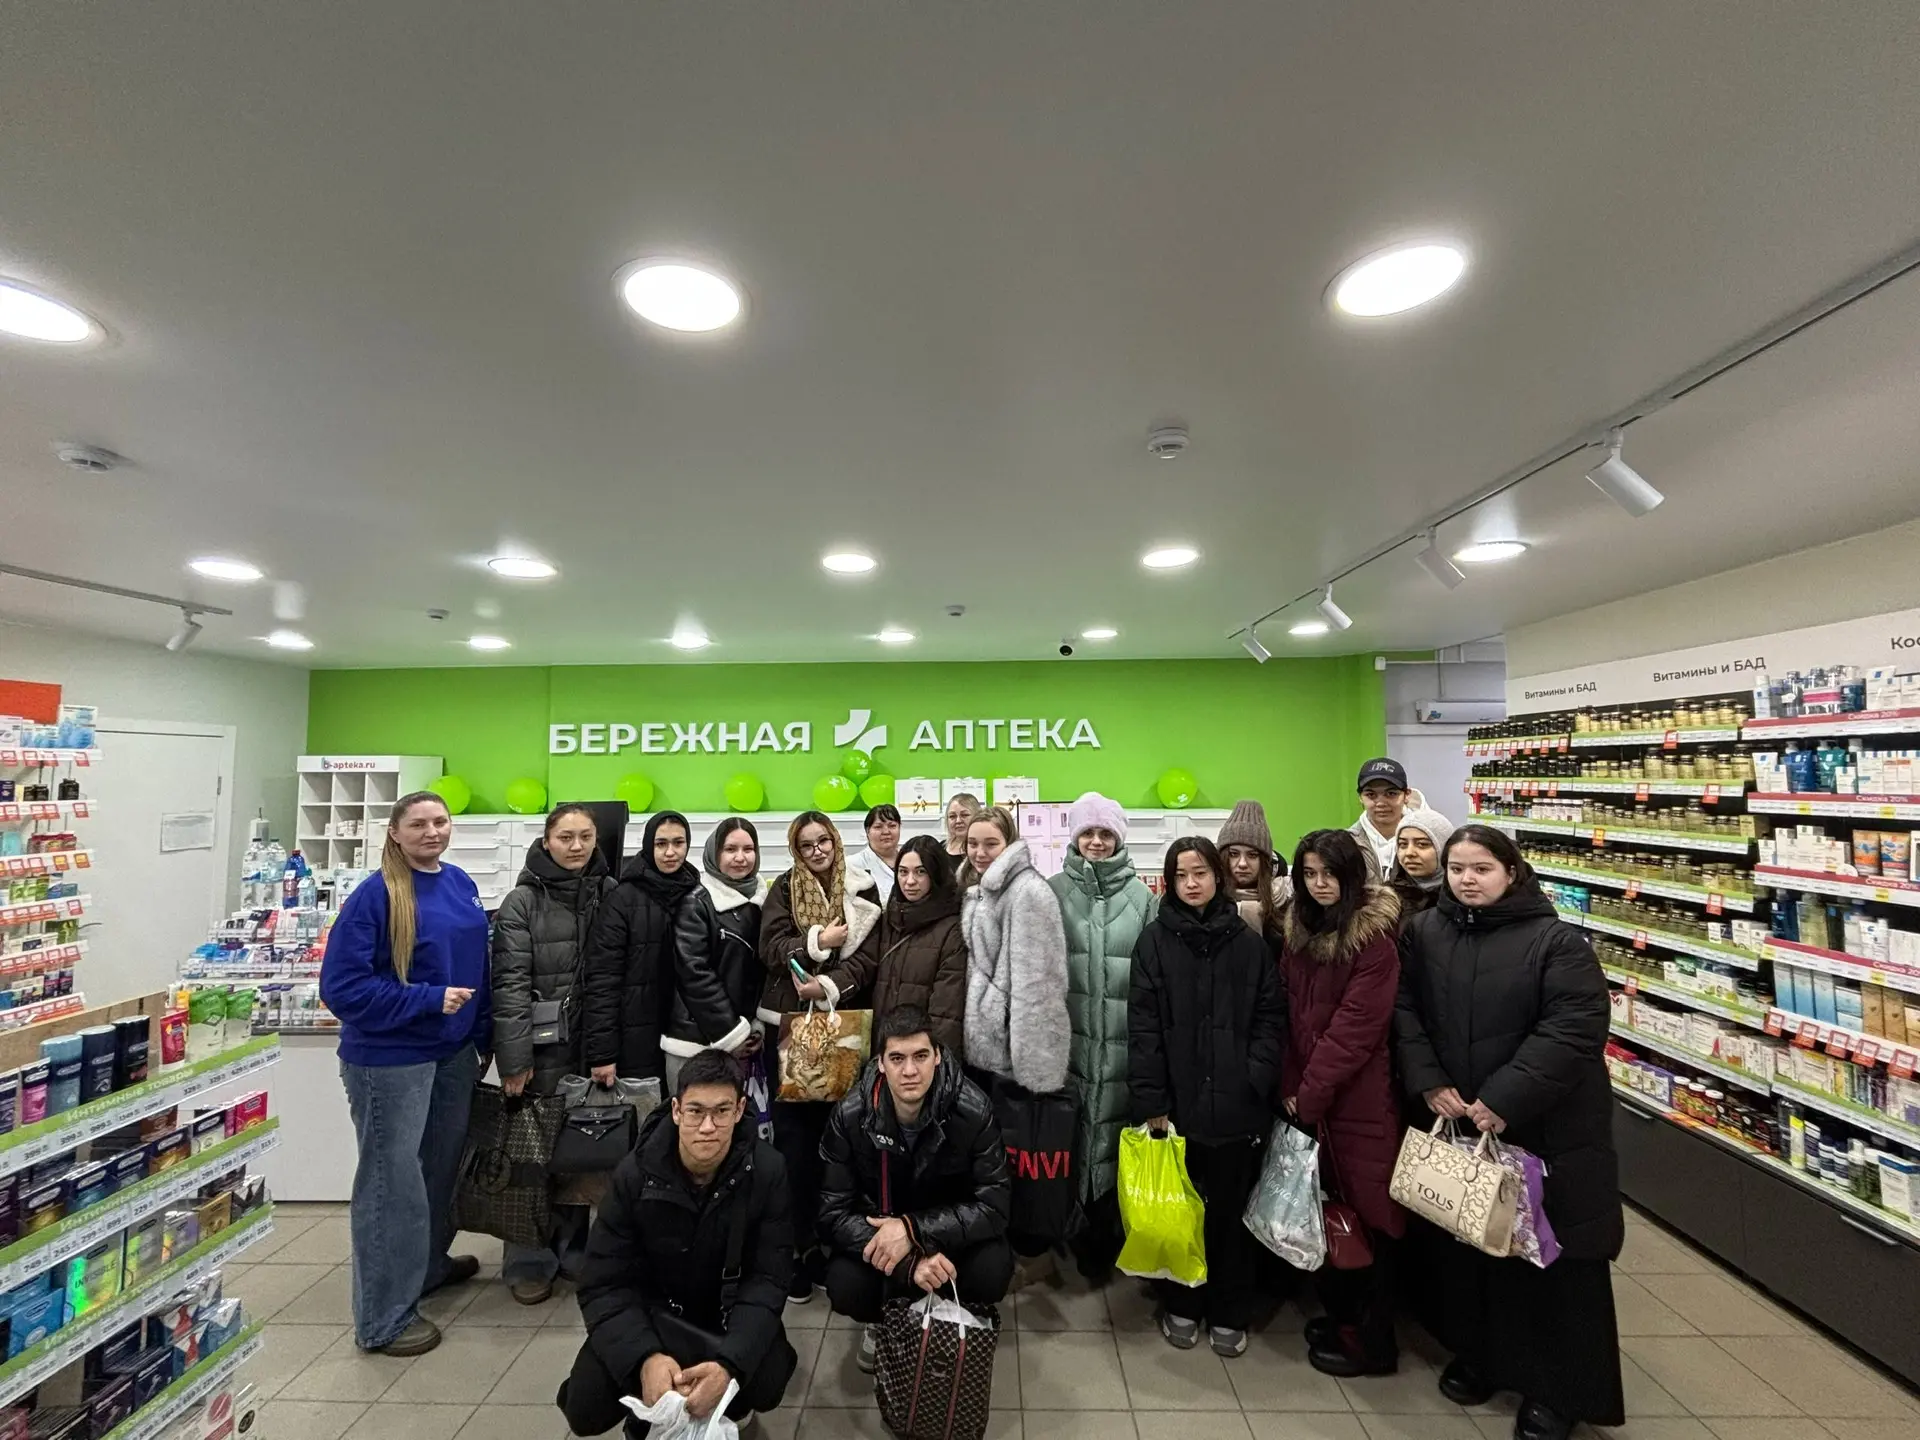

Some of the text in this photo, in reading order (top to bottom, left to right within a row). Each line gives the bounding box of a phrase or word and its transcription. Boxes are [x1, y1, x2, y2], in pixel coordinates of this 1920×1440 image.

[1653, 656, 1766, 683] Витамины и БАД
[1524, 681, 1597, 700] Витамины и БАД
[549, 718, 1101, 754] БЕРЕЖНАЯ АПТЕКА
[321, 757, 376, 771] b-apteka.ru
[66, 1085, 145, 1122] Интимные
[1417, 1181, 1454, 1211] TOUS
